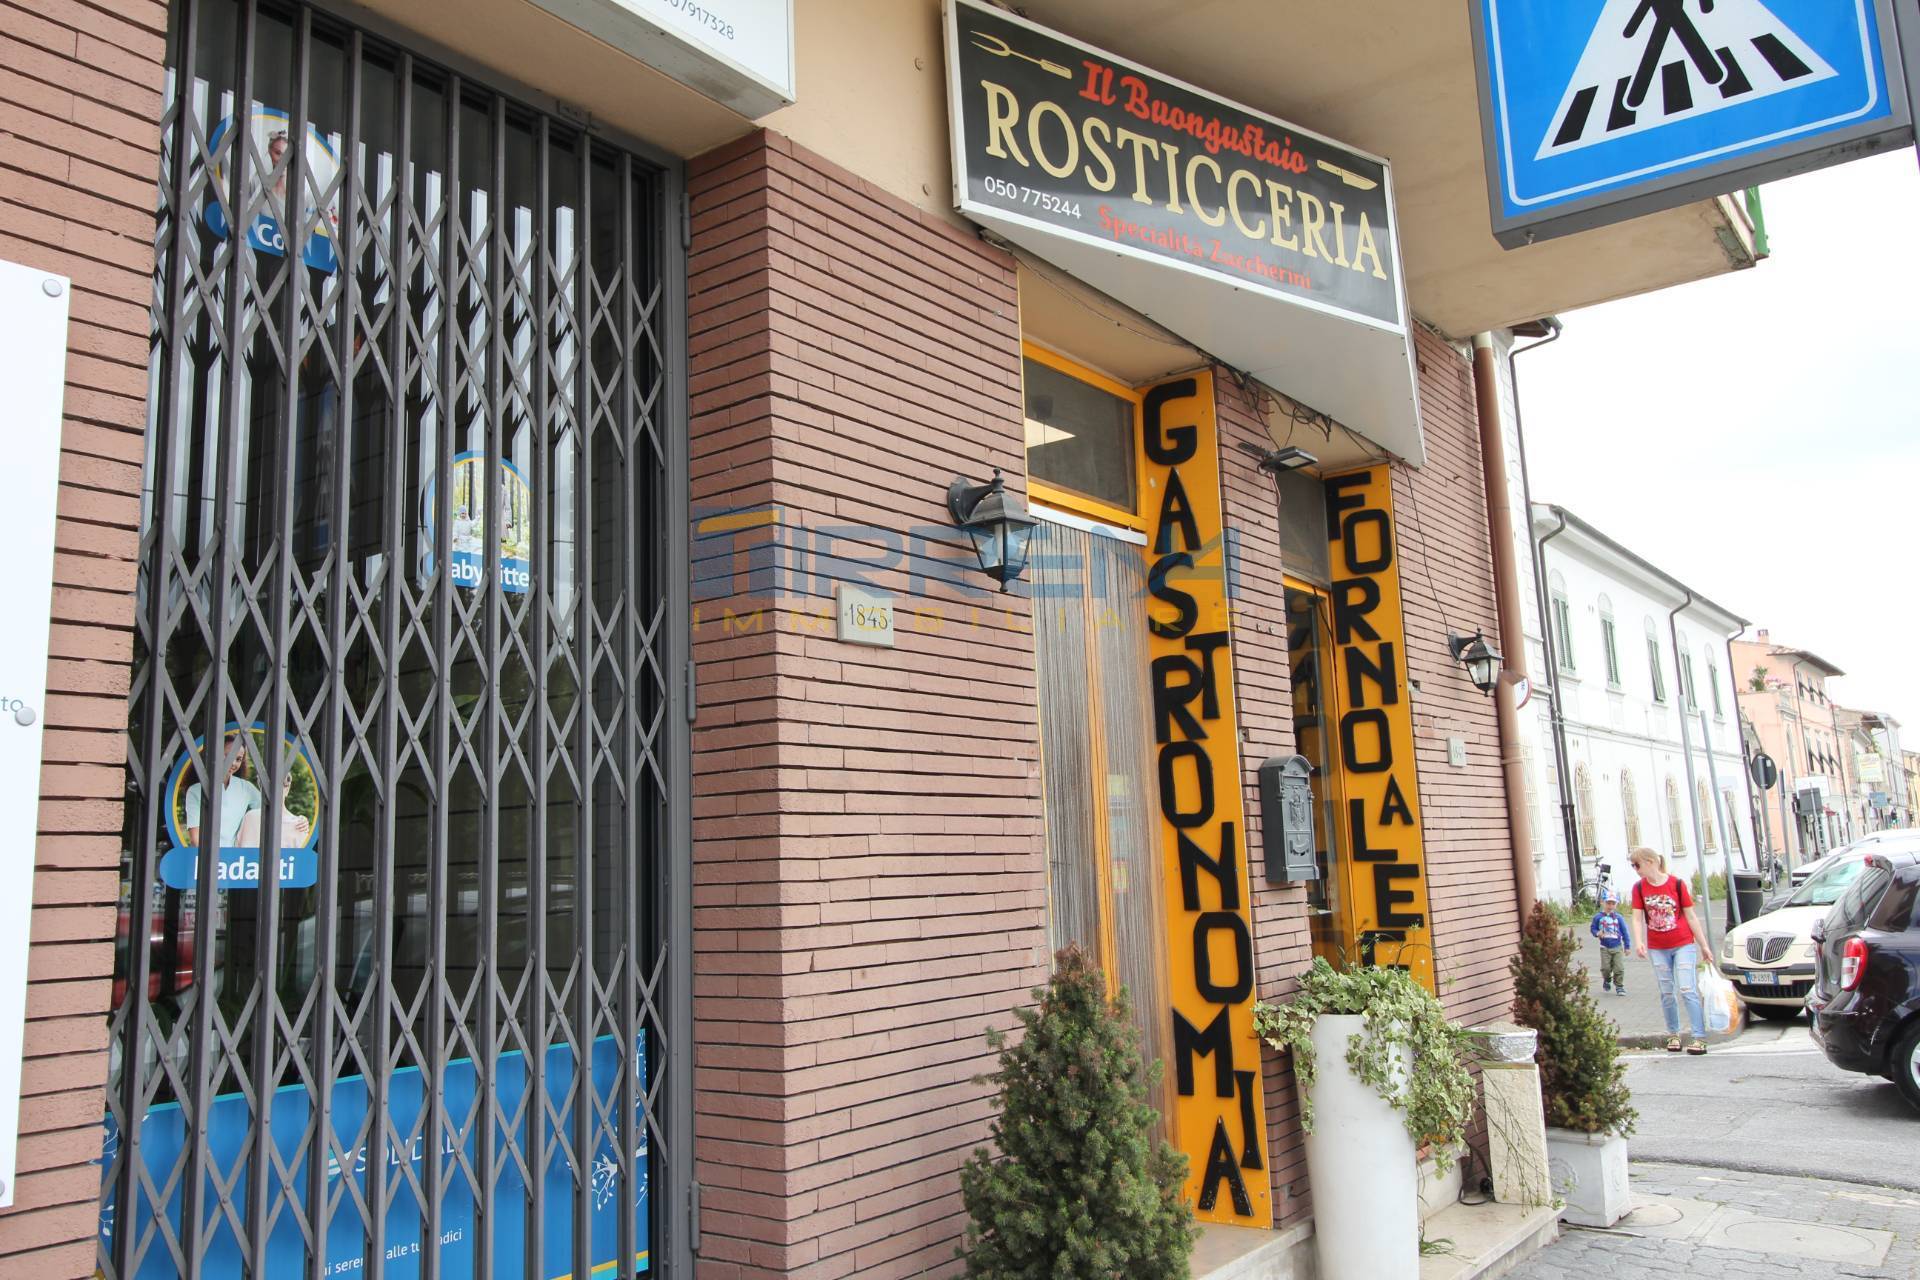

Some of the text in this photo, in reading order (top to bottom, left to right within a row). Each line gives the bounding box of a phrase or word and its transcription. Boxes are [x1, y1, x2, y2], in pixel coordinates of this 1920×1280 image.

[1079, 61, 1308, 174] Il Buongustaio
[981, 79, 1387, 281] ROSTICCERIA
[984, 176, 1082, 220] 050 775244
[848, 603, 888, 630] 1845
[1143, 378, 1264, 1217] GASTRONOMIA
[194, 856, 295, 881] adati
[386, 1245, 408, 1260] alle
